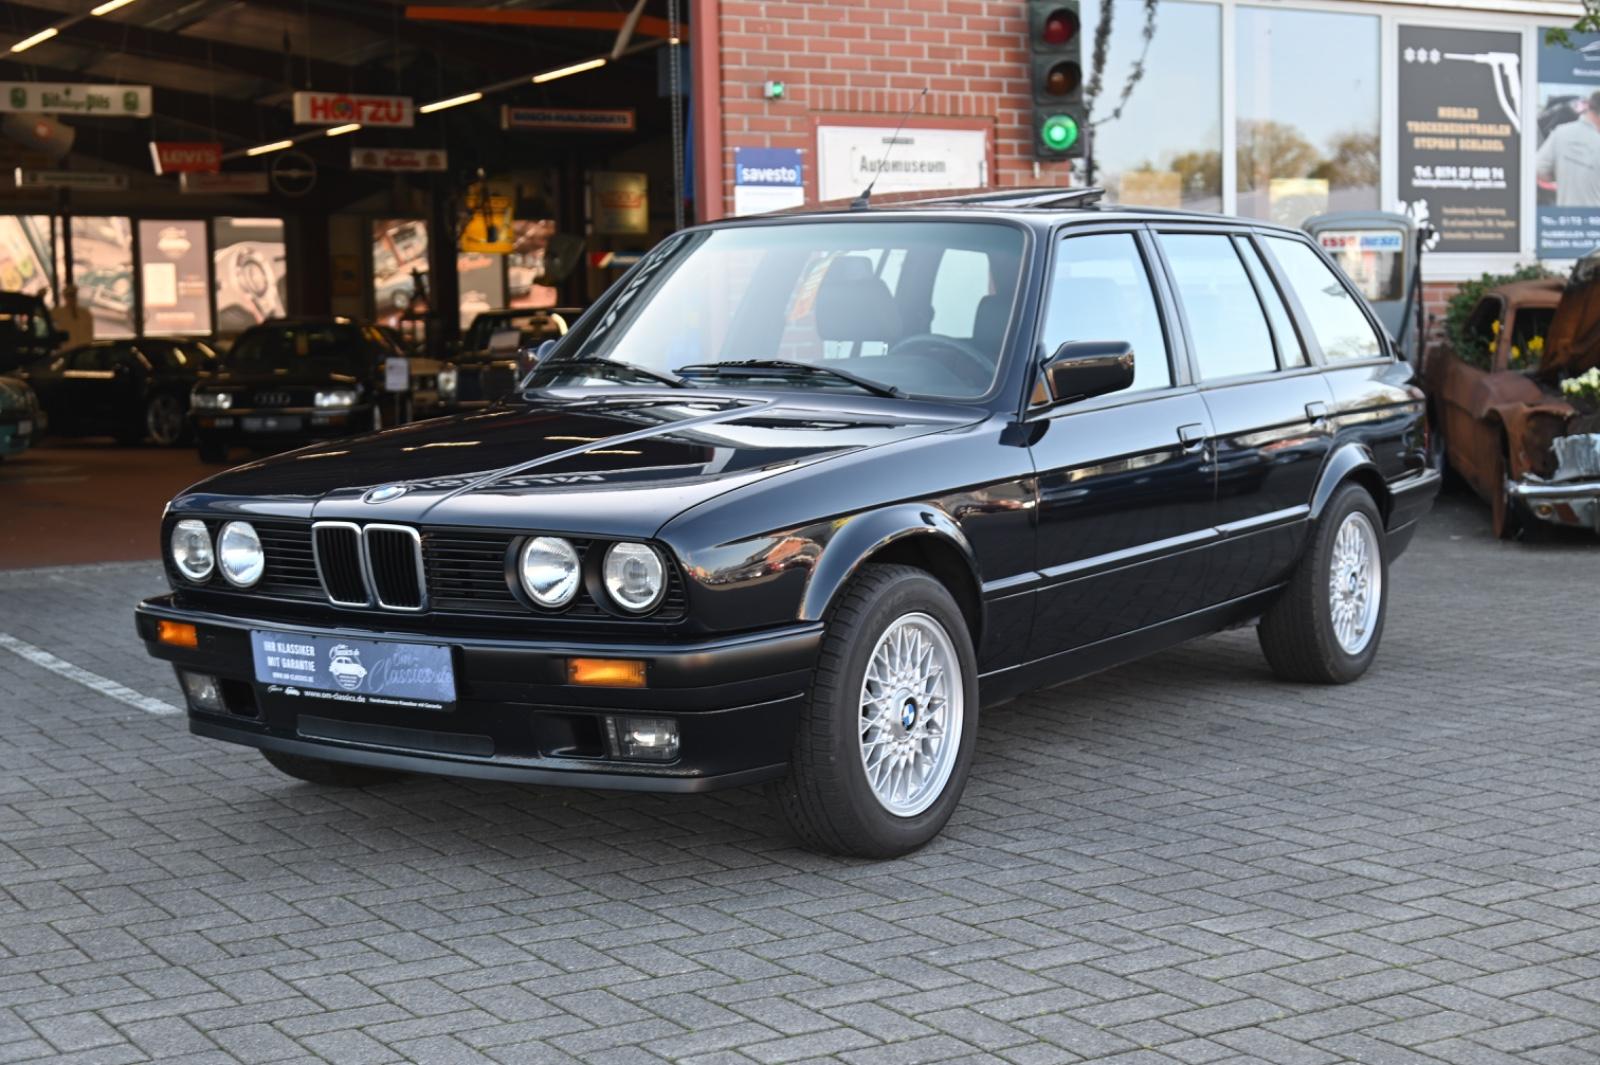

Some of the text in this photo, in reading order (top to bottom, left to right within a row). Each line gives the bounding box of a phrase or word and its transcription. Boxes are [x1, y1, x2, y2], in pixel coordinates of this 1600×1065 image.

[860, 155, 946, 173] Automuseum
[742, 165, 797, 183] savesto
[277, 642, 315, 657] KLASSIKER
[267, 656, 316, 672] MIT GARANTIE
